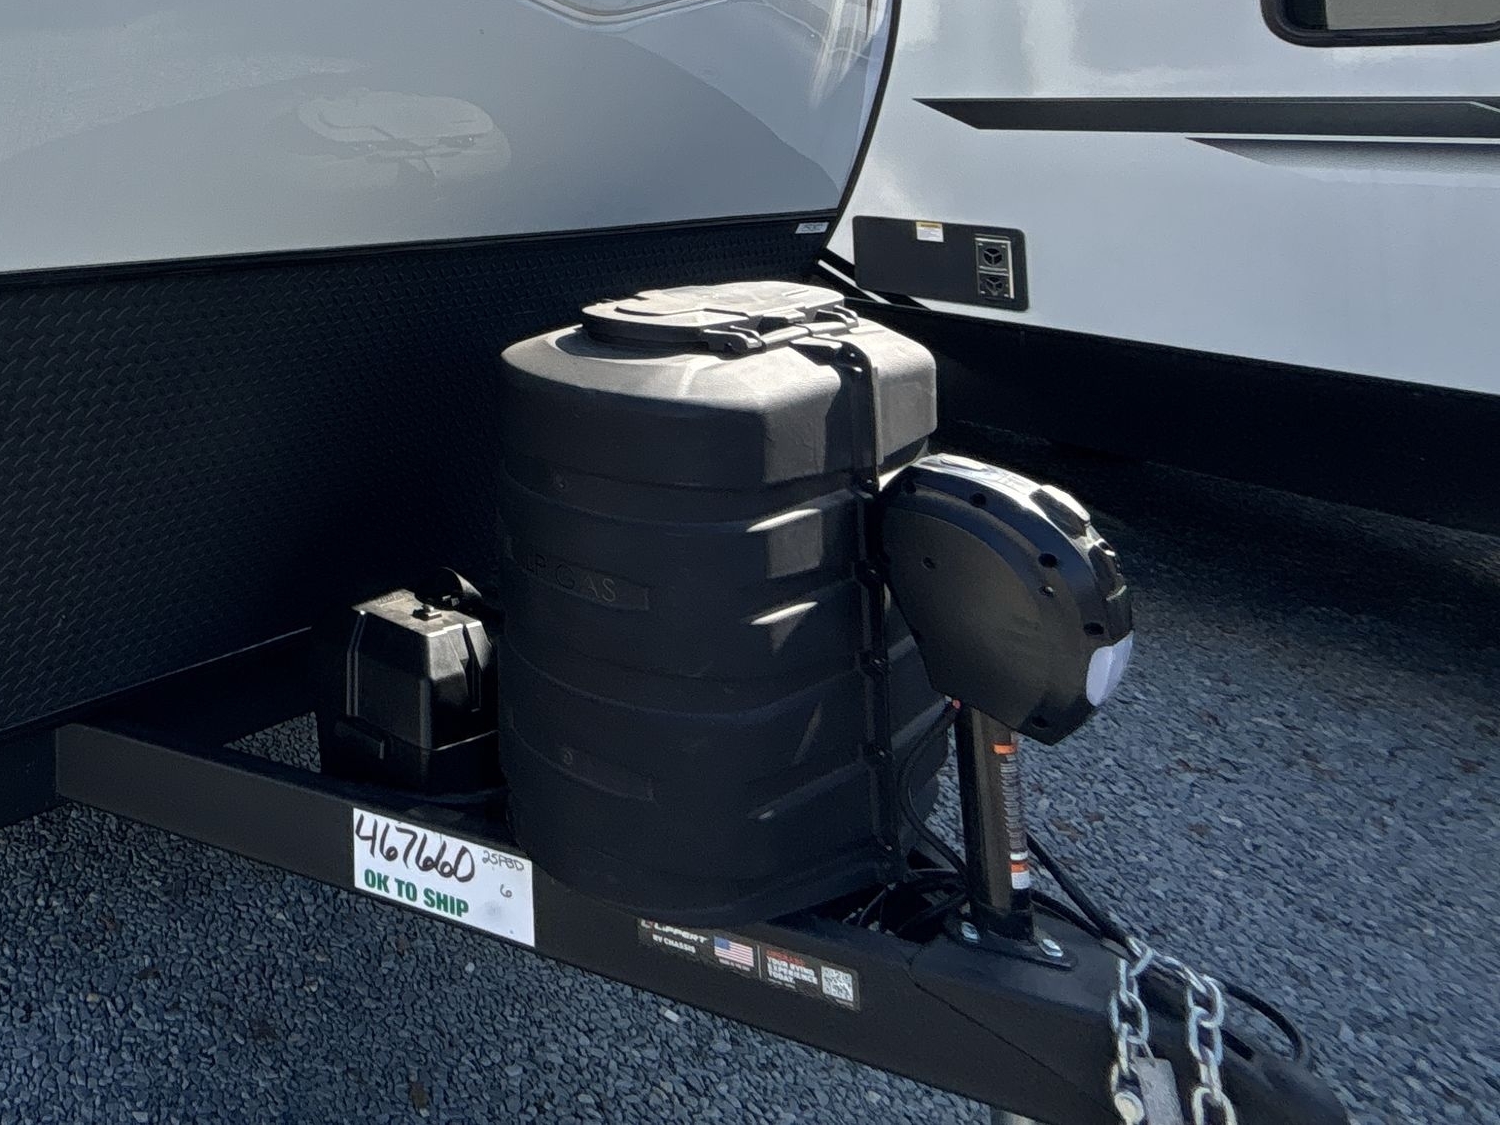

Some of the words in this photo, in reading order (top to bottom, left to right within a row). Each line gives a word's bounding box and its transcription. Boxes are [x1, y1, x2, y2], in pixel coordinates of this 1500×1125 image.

[555, 562, 617, 603] GAS
[355, 813, 476, 883] 467660
[364, 868, 390, 894] OK
[394, 877, 418, 902] TO
[423, 887, 469, 918] SHIP
